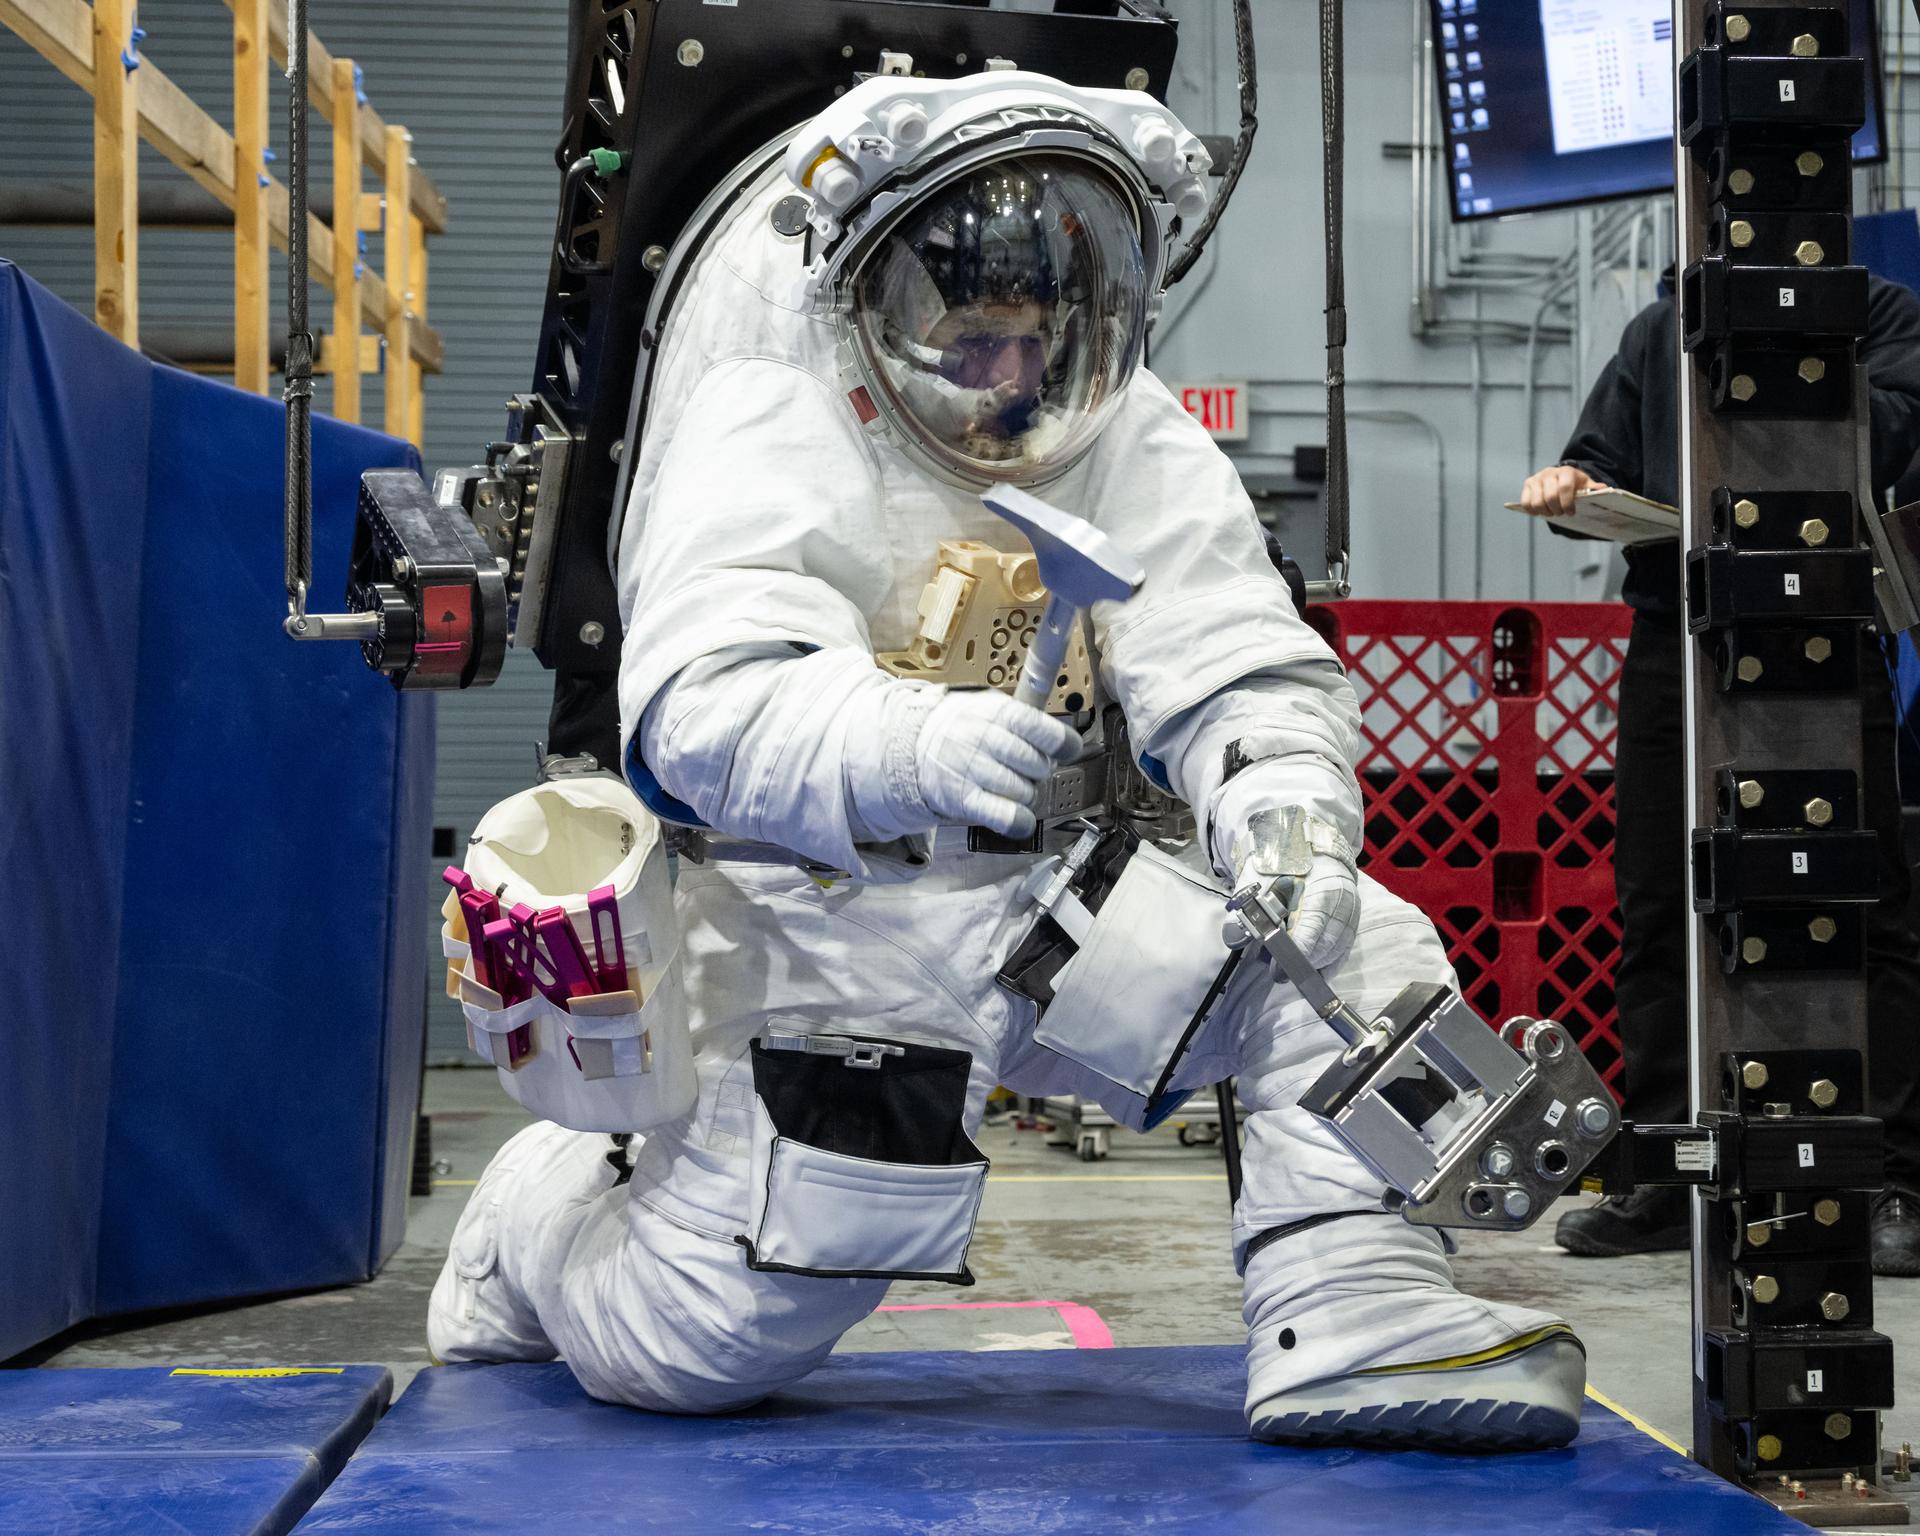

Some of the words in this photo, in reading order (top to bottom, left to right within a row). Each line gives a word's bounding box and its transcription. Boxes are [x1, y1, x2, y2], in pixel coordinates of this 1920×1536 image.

[1783, 83, 1790, 97] 6
[1782, 291, 1791, 304] 5
[1182, 388, 1237, 432] EXIT
[1787, 578, 1796, 591] 4
[1795, 856, 1803, 868] 3
[1802, 1148, 1809, 1161] 2
[1810, 1373, 1818, 1388] 1
